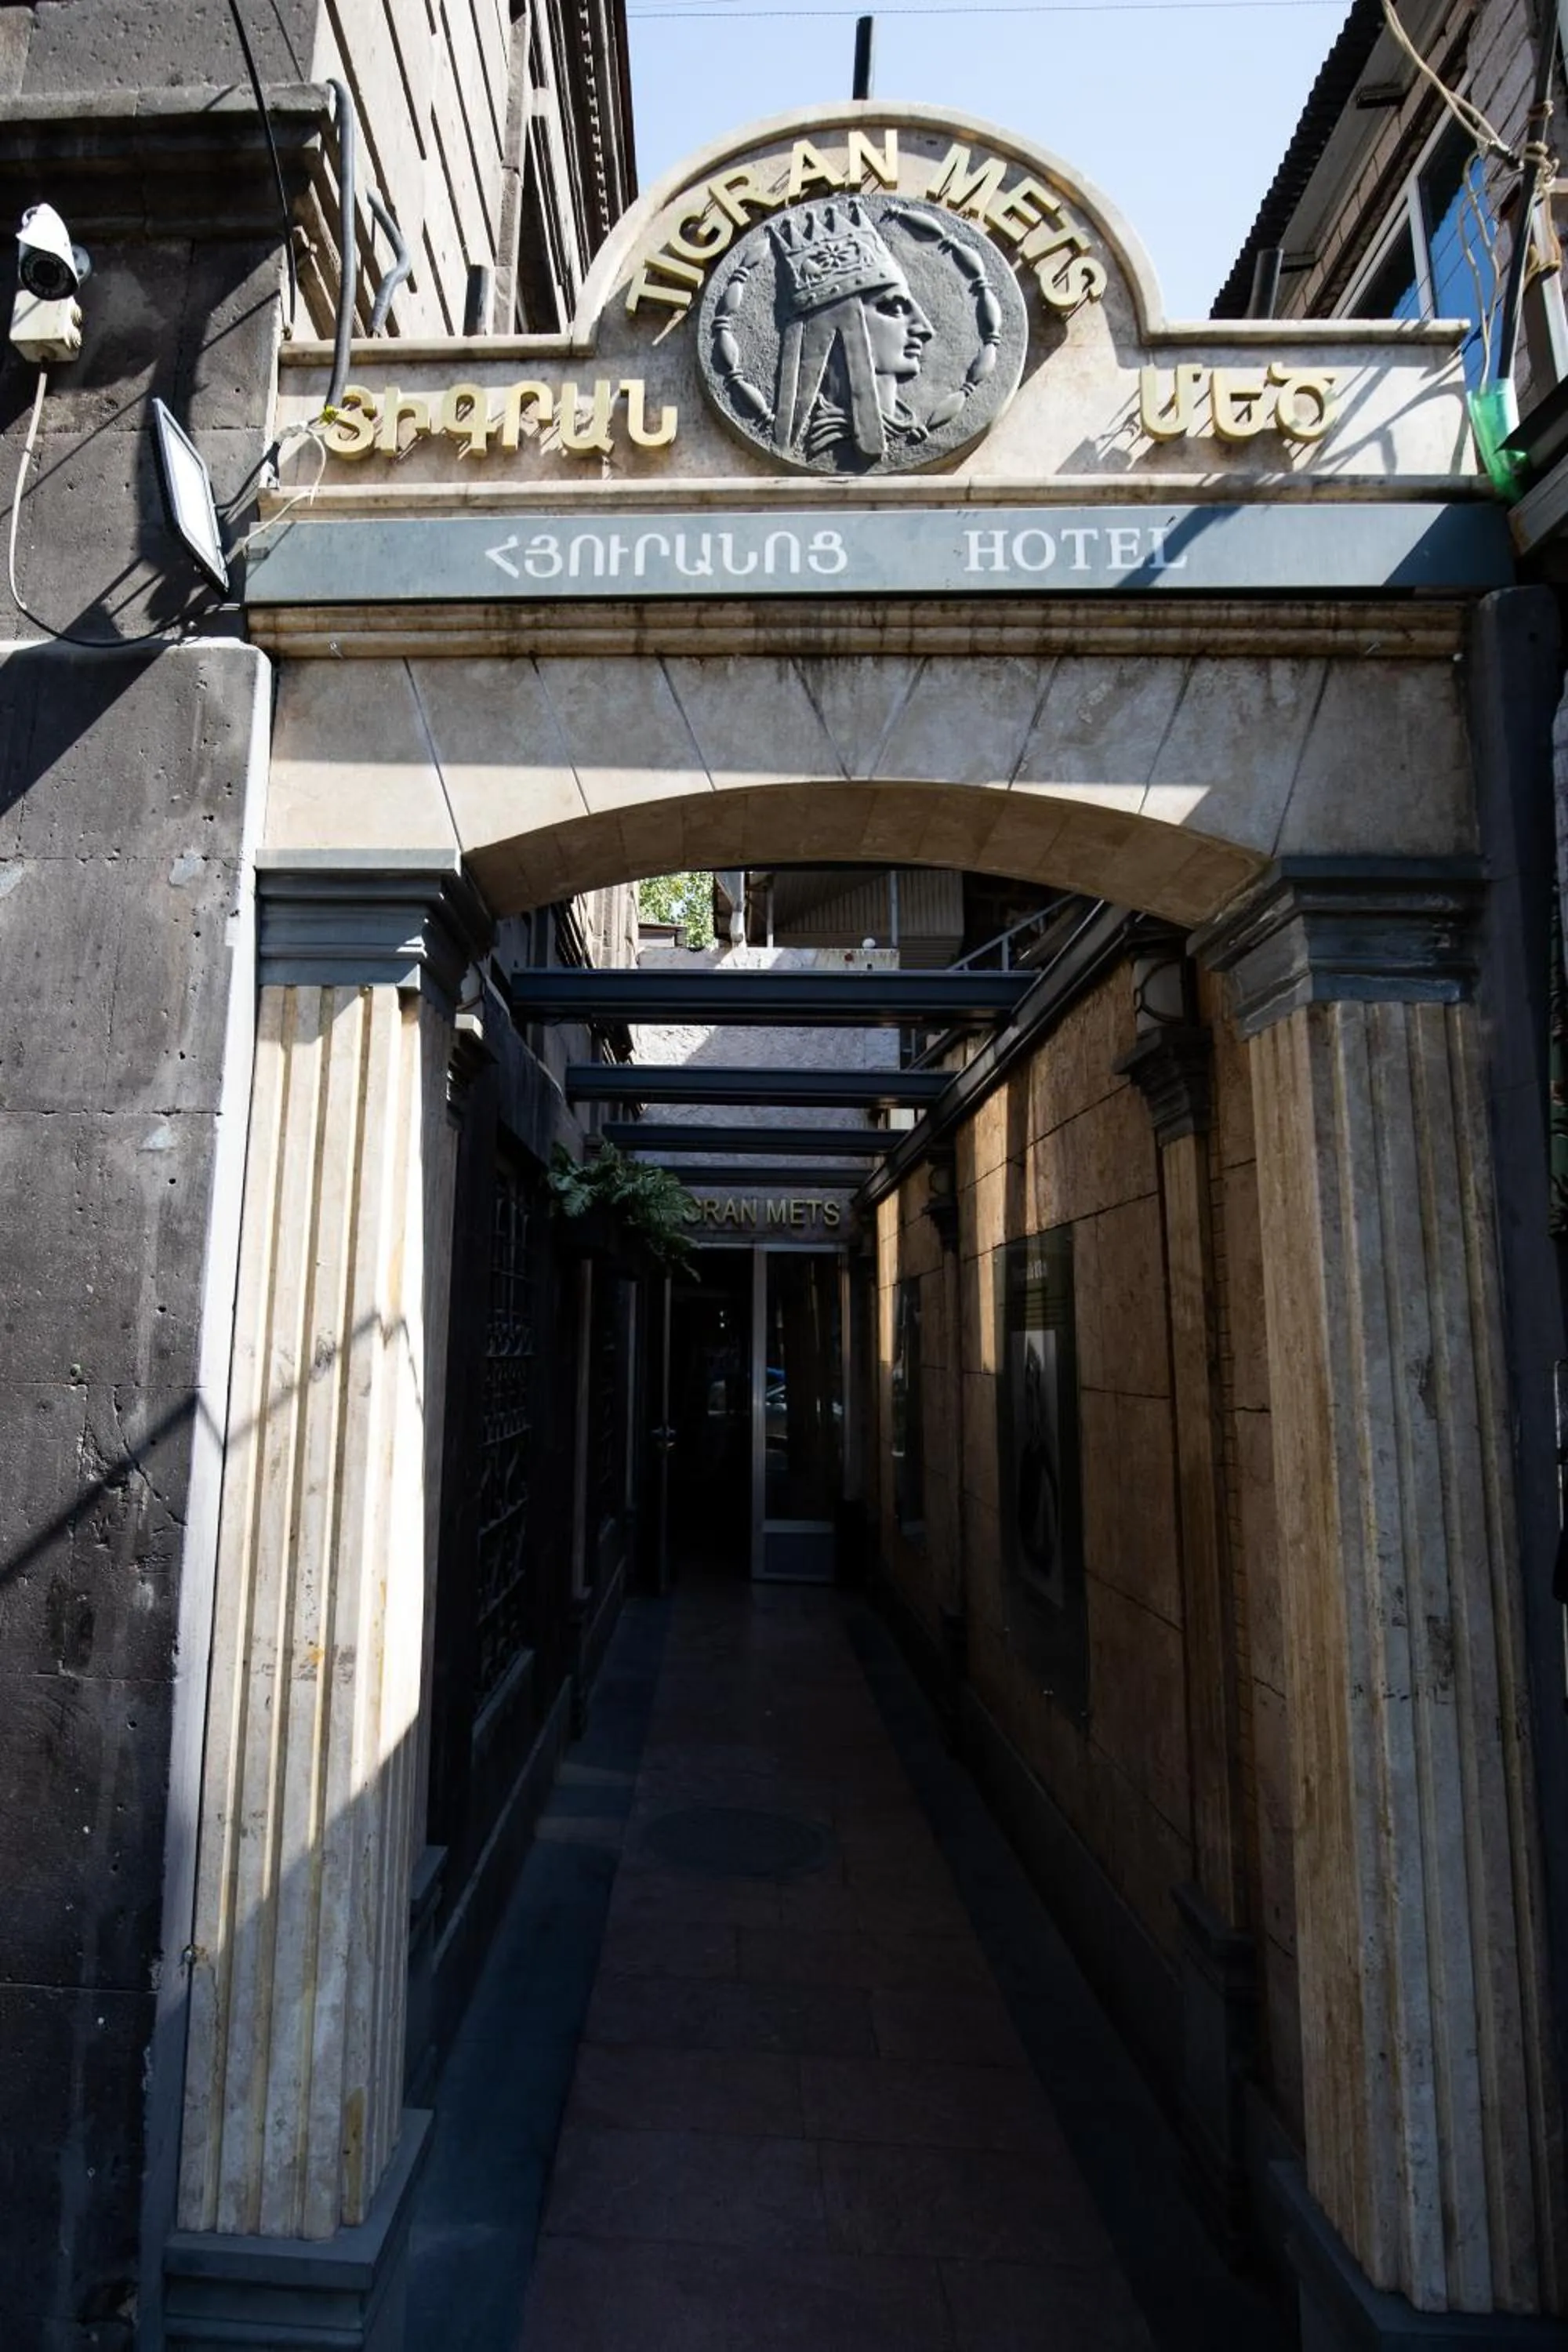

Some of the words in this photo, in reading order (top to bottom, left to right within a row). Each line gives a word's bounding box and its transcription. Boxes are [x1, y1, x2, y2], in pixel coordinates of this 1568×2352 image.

[627, 130, 898, 314] TIGRAN
[926, 143, 1107, 310] METS
[325, 379, 677, 459] ՏԻԳՐԱՆ
[1140, 363, 1341, 443] ՄԵԾ
[485, 531, 848, 578] ՀՅՈՒՐԱՆՈՑ
[963, 528, 1187, 572] HOTEL
[766, 1200, 841, 1225] METS
